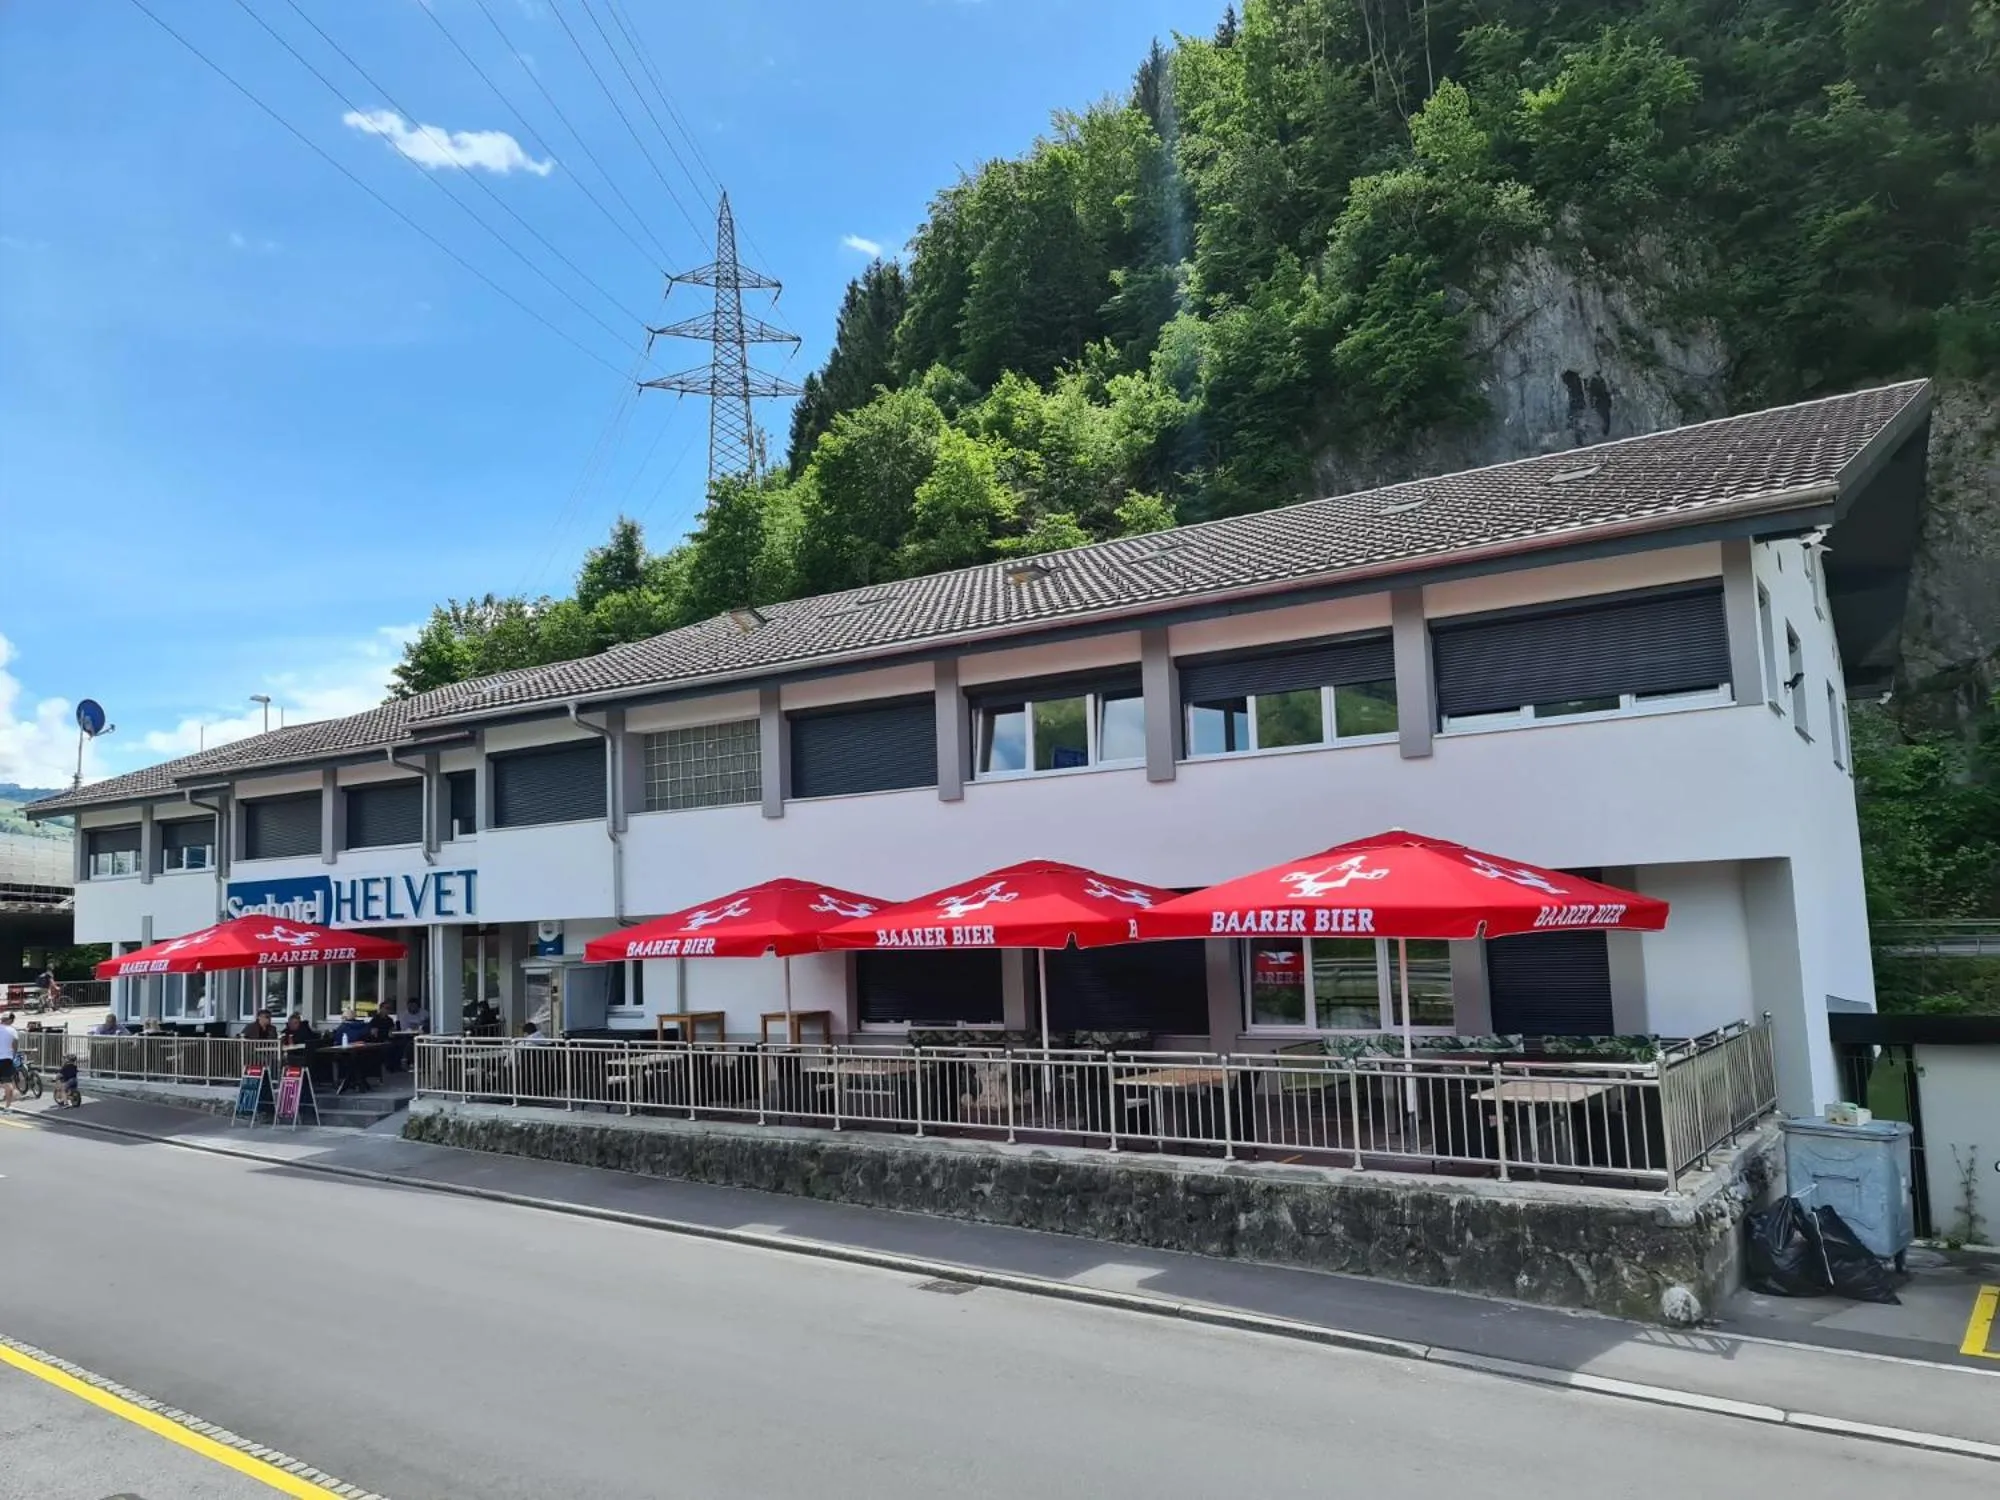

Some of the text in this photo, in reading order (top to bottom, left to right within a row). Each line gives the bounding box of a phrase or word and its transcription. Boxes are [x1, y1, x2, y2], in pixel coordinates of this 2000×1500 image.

[333, 869, 478, 923] HELVET
[1211, 909, 1375, 932] BAARER BIER
[1533, 904, 1626, 927] BAARER BIER
[876, 925, 995, 946] BAARER BIER
[257, 947, 357, 964] BAARER BIER
[626, 937, 715, 957] BAARER BIER
